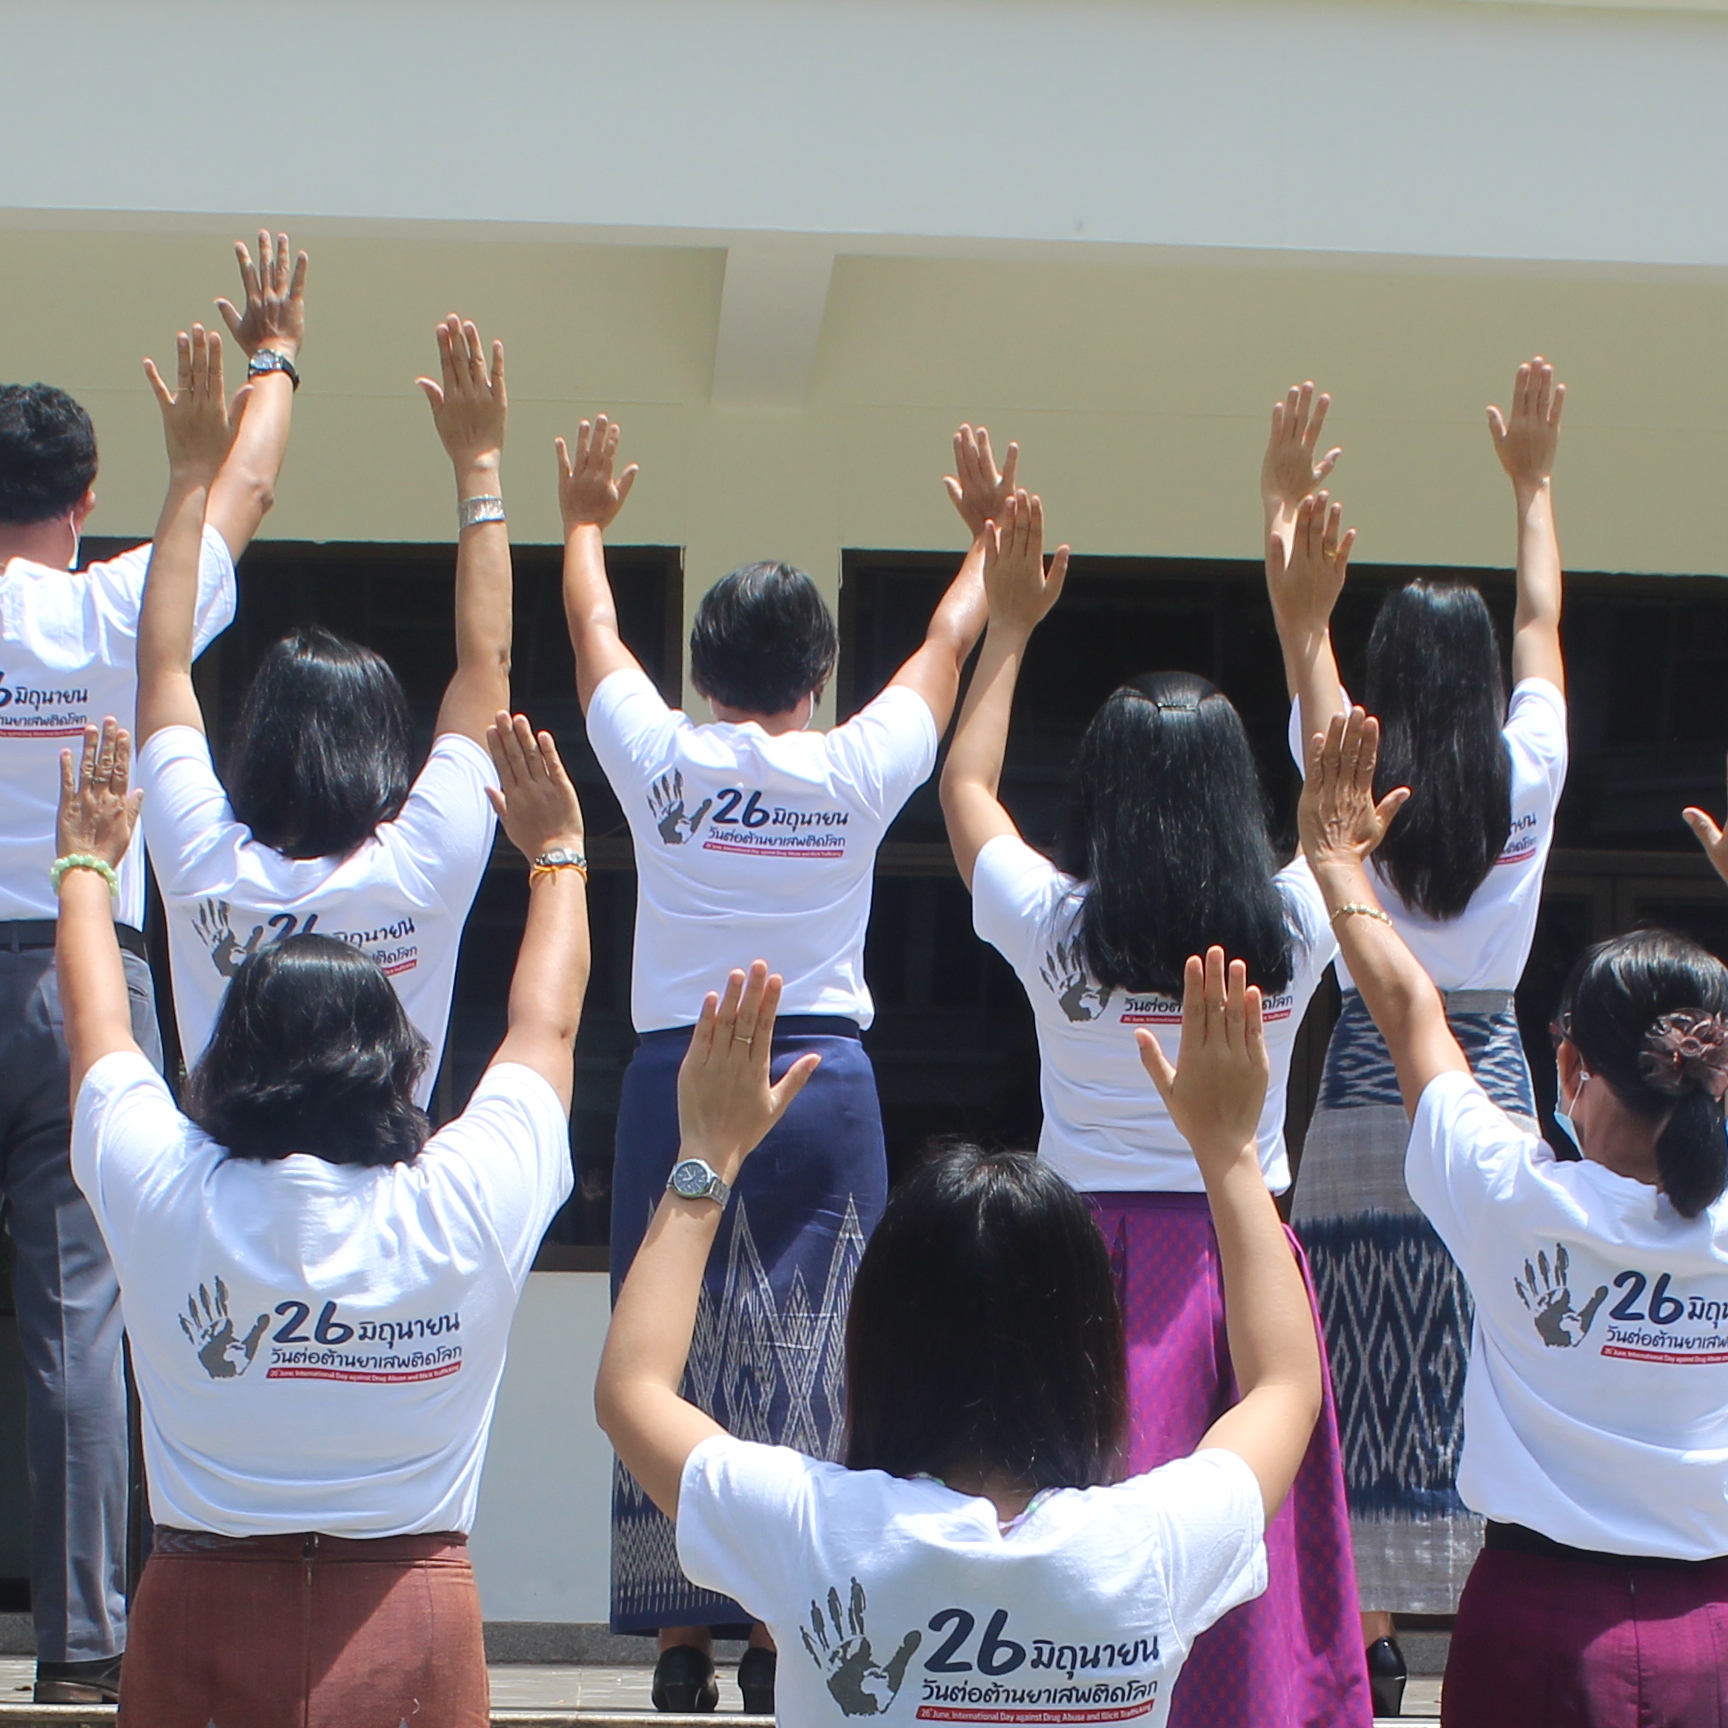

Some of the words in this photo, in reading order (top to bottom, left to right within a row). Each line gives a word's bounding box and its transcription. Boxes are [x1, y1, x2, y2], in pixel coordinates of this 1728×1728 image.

[14, 686, 88, 711] มิถุนายน
[712, 788, 770, 828] 26
[772, 807, 849, 832] มิถุนายน
[1609, 1270, 1684, 1325] 26
[272, 1300, 354, 1345] 26
[358, 1311, 460, 1349] มิถุนายน
[923, 1608, 1027, 1676] 26
[1030, 1636, 1160, 1680] มิถุนายน
[922, 1679, 1158, 1704] วันต่อต้านยาเสพติดโลก
